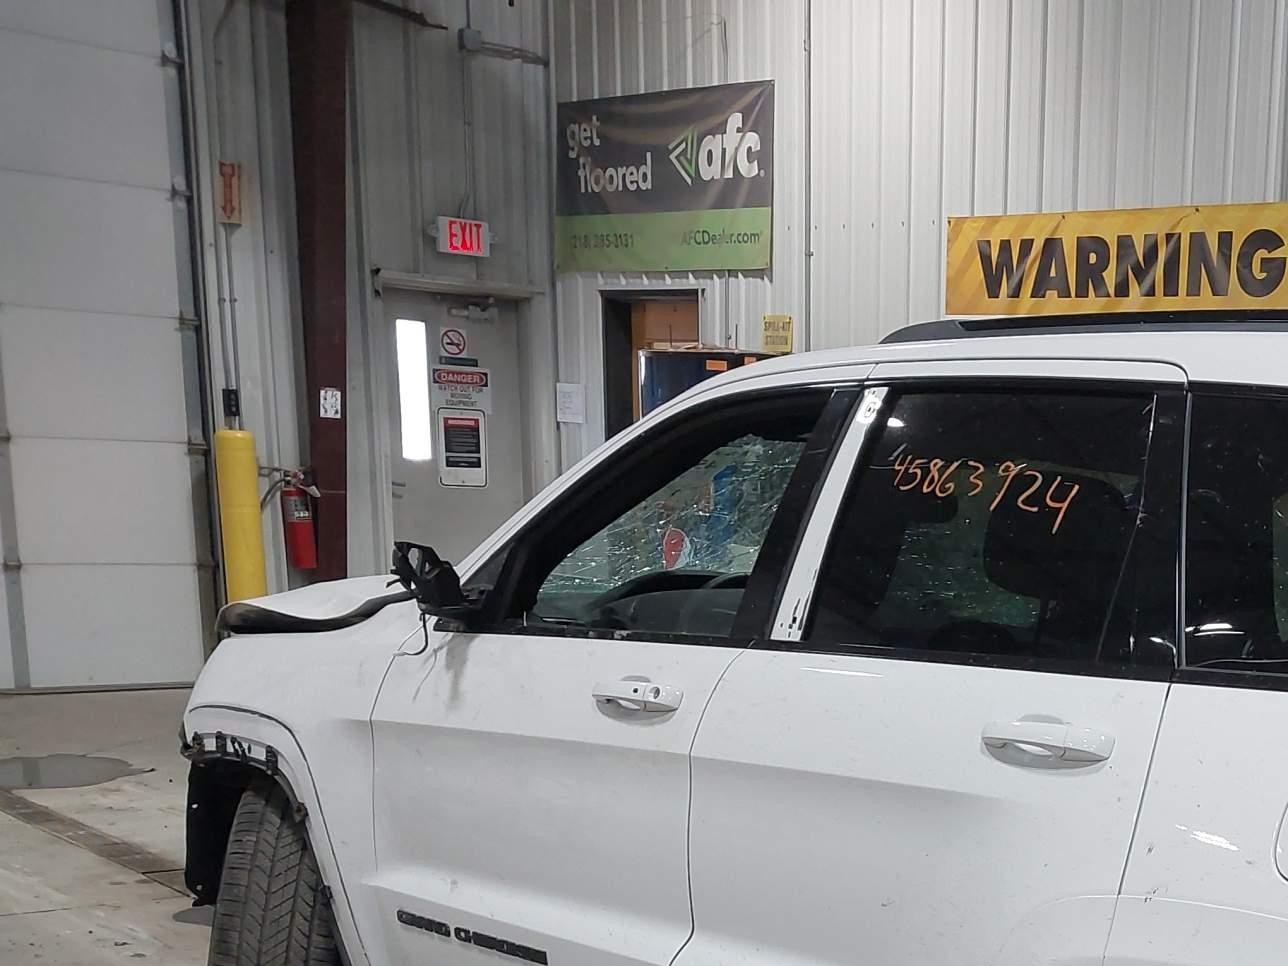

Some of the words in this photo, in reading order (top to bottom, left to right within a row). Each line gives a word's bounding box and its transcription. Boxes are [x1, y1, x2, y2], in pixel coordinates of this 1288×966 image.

[567, 114, 600, 158] get
[578, 151, 652, 193] floored
[449, 220, 482, 251] EXIT
[976, 228, 1287, 299] WARNING
[440, 372, 480, 383] DANGER
[894, 454, 1080, 535] 45863924
